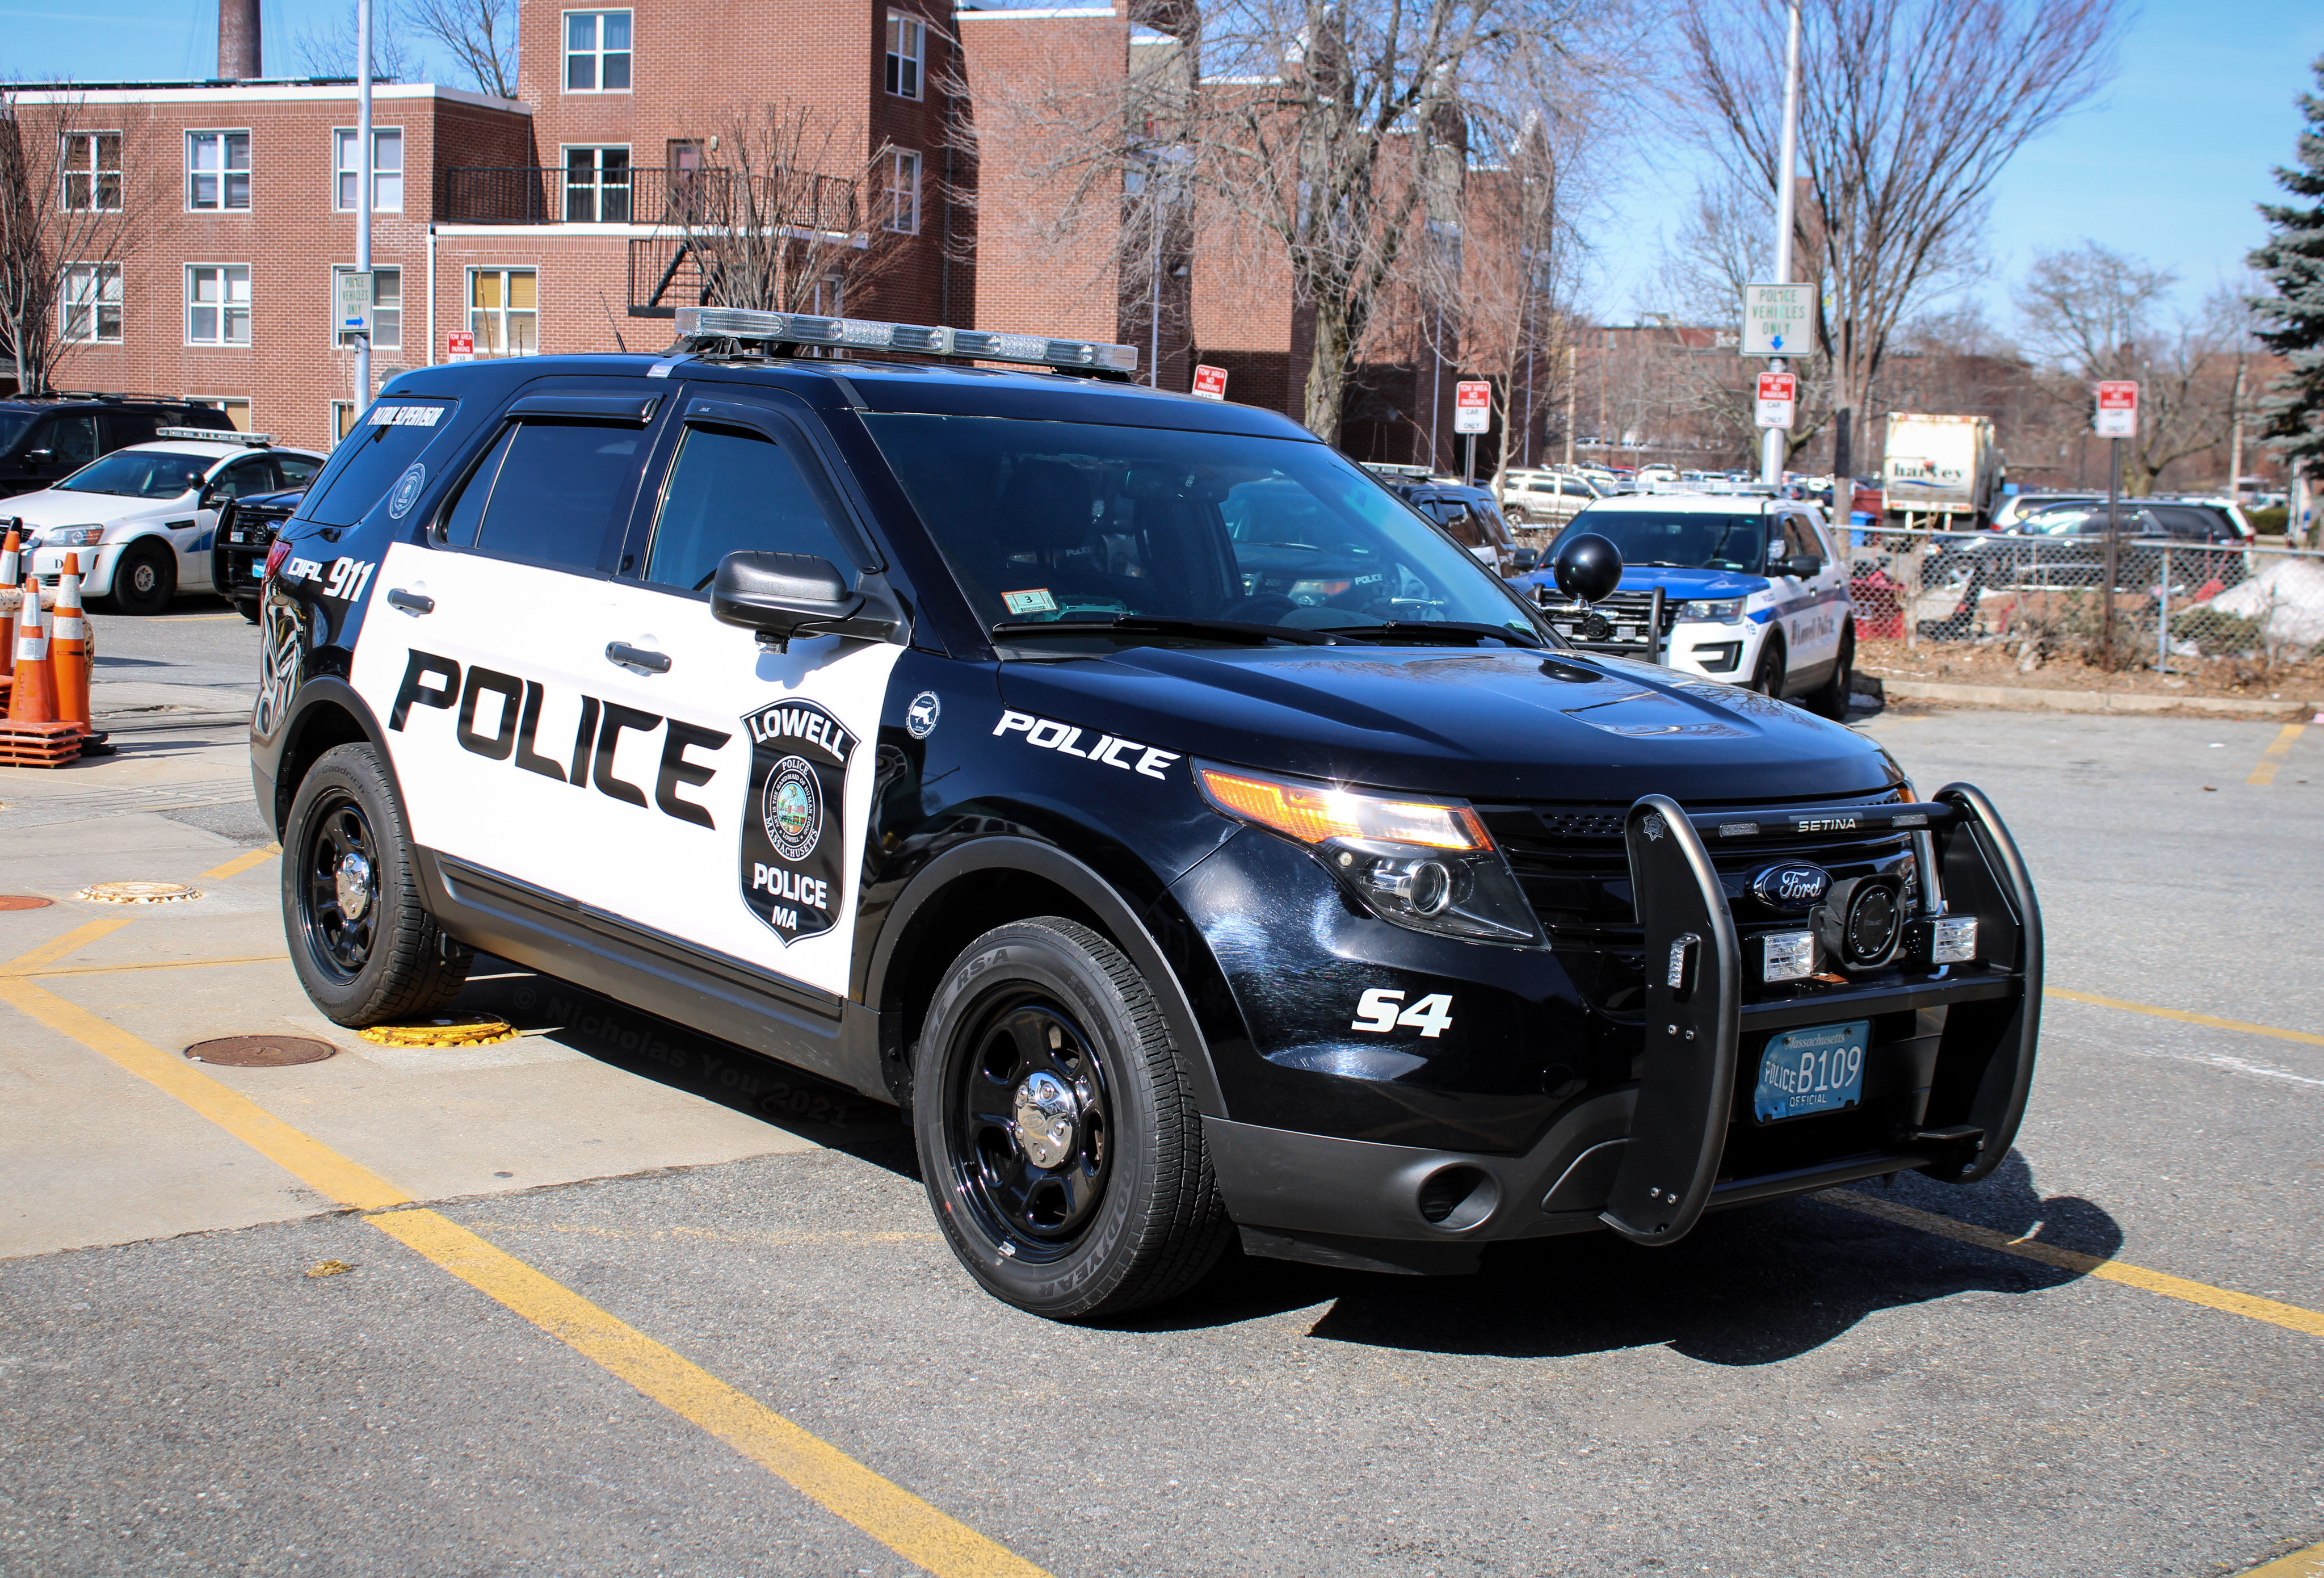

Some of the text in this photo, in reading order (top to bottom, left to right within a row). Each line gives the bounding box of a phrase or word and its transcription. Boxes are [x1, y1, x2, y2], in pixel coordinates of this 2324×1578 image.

[345, 276, 364, 288] POLICE
[342, 289, 368, 301] VEHICLES
[1759, 288, 1798, 303] POLICE
[347, 304, 362, 315] ONLY
[1753, 305, 1806, 319] VEHICLES
[1763, 321, 1791, 336] ONLY
[1198, 368, 1225, 379] TOW AREA
[1197, 381, 1220, 392] PARKING
[287, 556, 376, 602] DIAL 911
[1354, 573, 1383, 585] POLICE
[388, 648, 732, 830] POLICE
[750, 708, 844, 762] LOWELL
[992, 710, 1181, 780] POLICE
[781, 759, 809, 775] POLICE
[776, 773, 800, 790] HANDMAID
[799, 778, 806, 786] OF
[804, 784, 813, 814] HUMAN
[803, 818, 812, 836] GOOD
[1798, 818, 1856, 832] SETINA
[766, 817, 818, 858] MASSACHUSETTS
[783, 831, 800, 843] LOWELL
[753, 862, 827, 910] POLICE
[1779, 871, 1822, 899] Ford
[771, 905, 797, 931] MA
[1351, 988, 1453, 1038] S4
[1785, 1033, 1845, 1050] Massachusetts
[1764, 1045, 1861, 1094] POLICE B109
[1789, 1093, 1827, 1107] OFFICIAL
